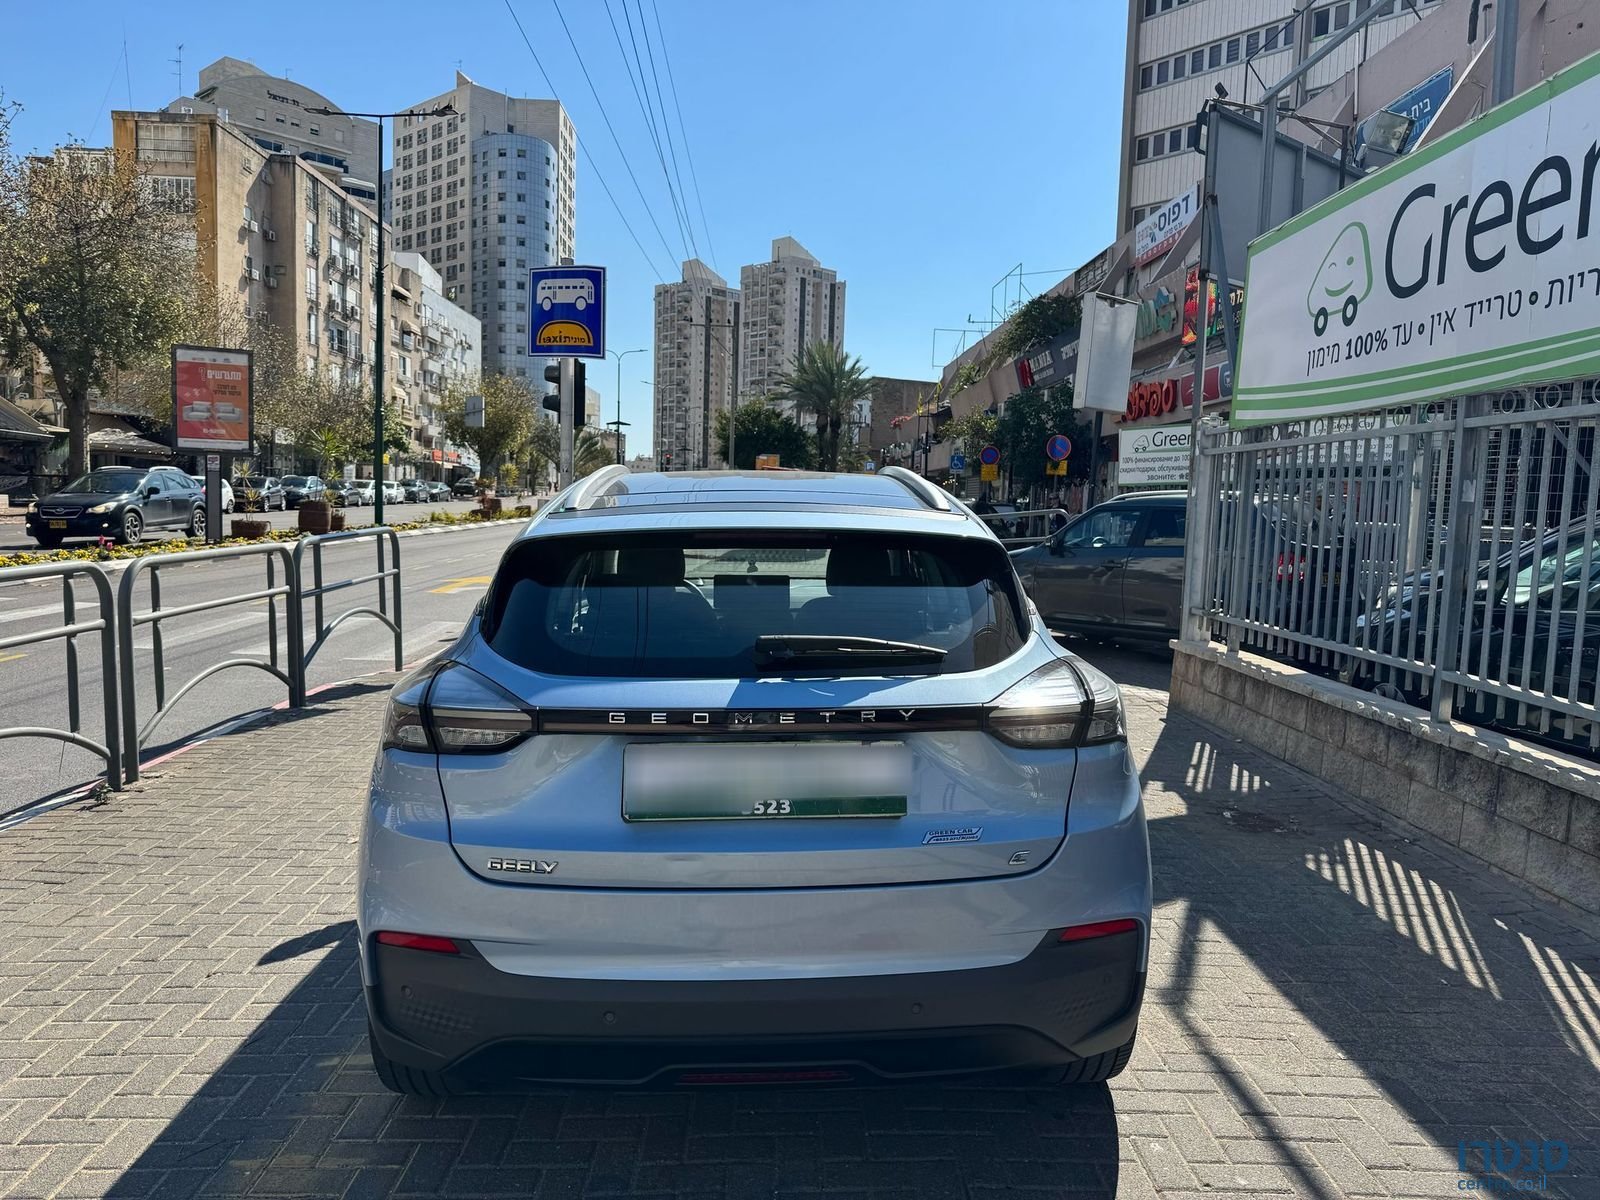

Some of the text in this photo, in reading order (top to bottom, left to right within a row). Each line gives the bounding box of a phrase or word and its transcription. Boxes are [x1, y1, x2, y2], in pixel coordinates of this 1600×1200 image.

[1157, 194, 1191, 232] דפוס
[1464, 288, 1523, 328] טרייד
[542, 330, 562, 344] taxi
[563, 335, 586, 344] מונית
[1392, 320, 1413, 347] עד
[1429, 307, 1457, 346] אין
[1306, 341, 1341, 377] מימון
[1345, 327, 1388, 361] 100%
[608, 709, 916, 725] GEOMETRY
[487, 857, 559, 874] GEELY
